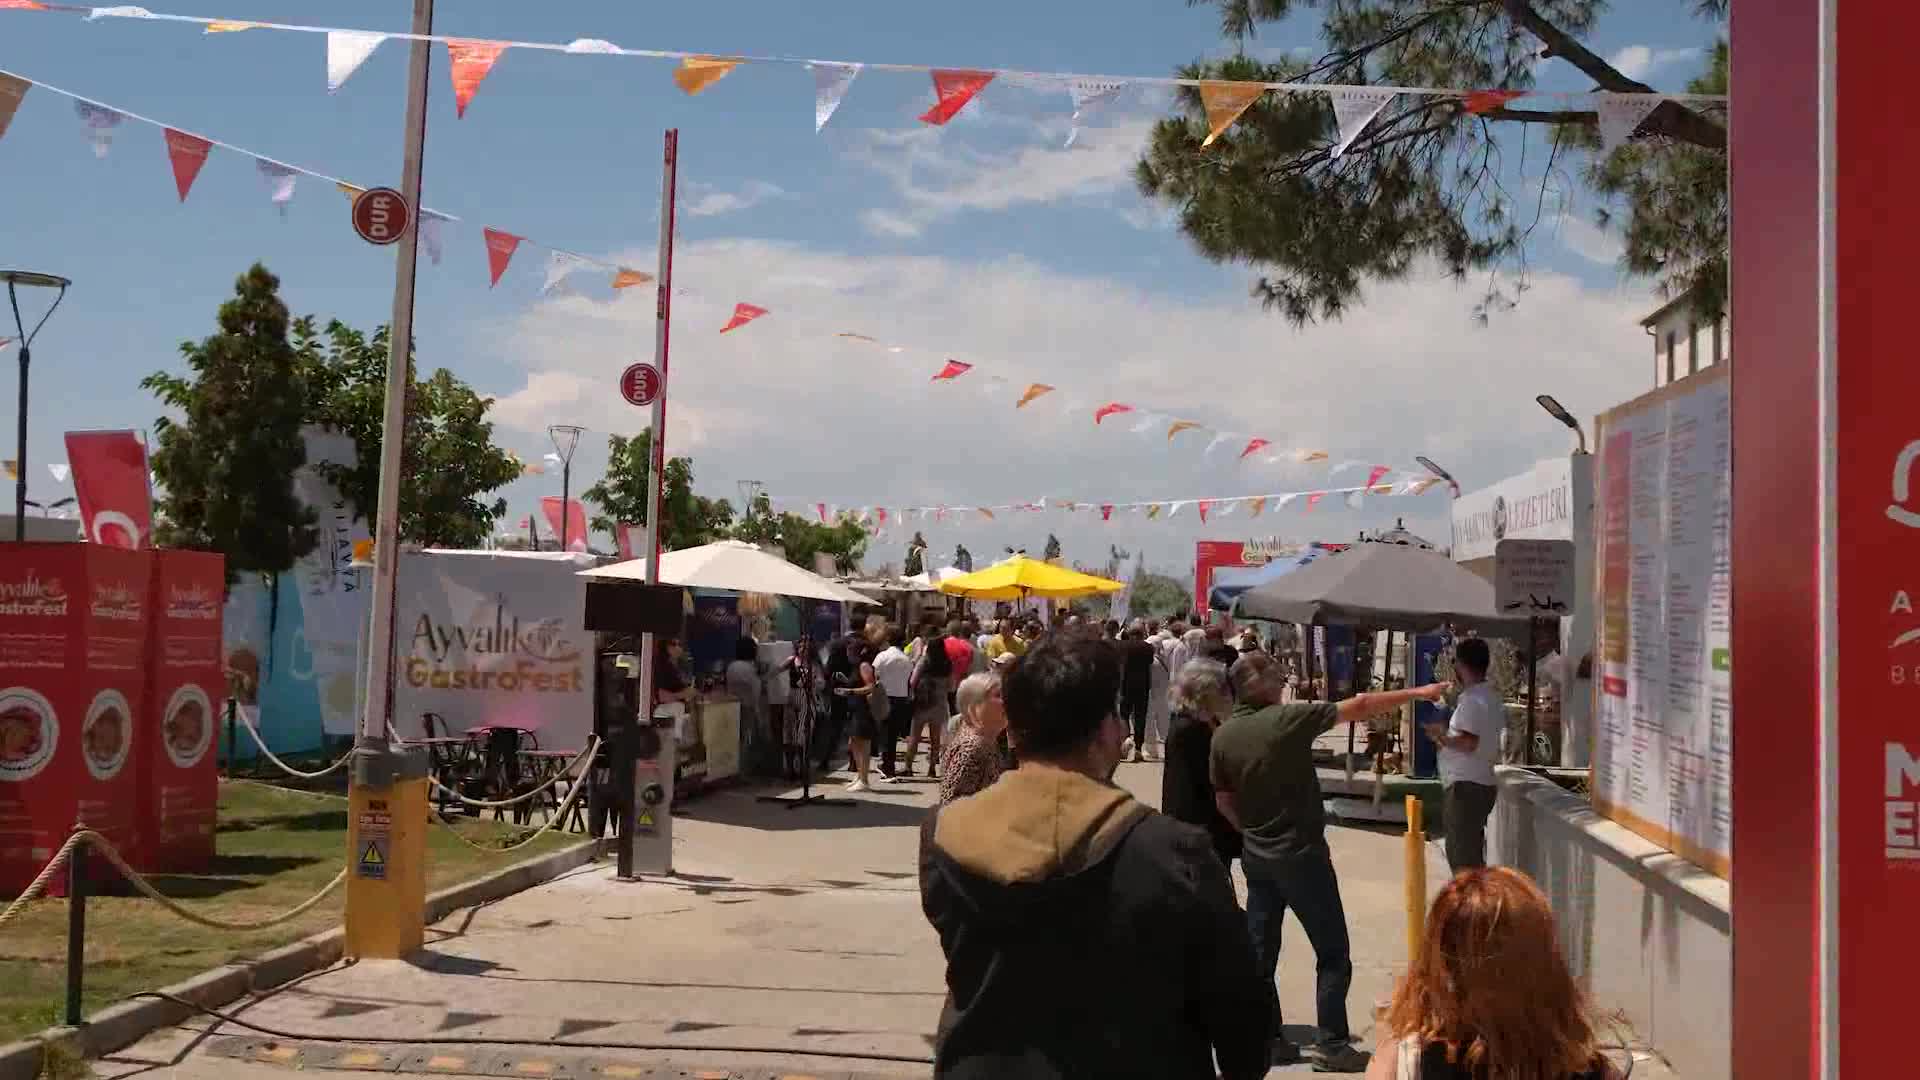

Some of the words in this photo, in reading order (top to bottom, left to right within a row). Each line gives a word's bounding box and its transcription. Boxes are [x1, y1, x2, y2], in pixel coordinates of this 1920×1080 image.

[370, 196, 391, 236] DUR
[633, 370, 648, 400] DUR
[0, 600, 67, 616] astroFest
[406, 657, 583, 692] GastroFest
